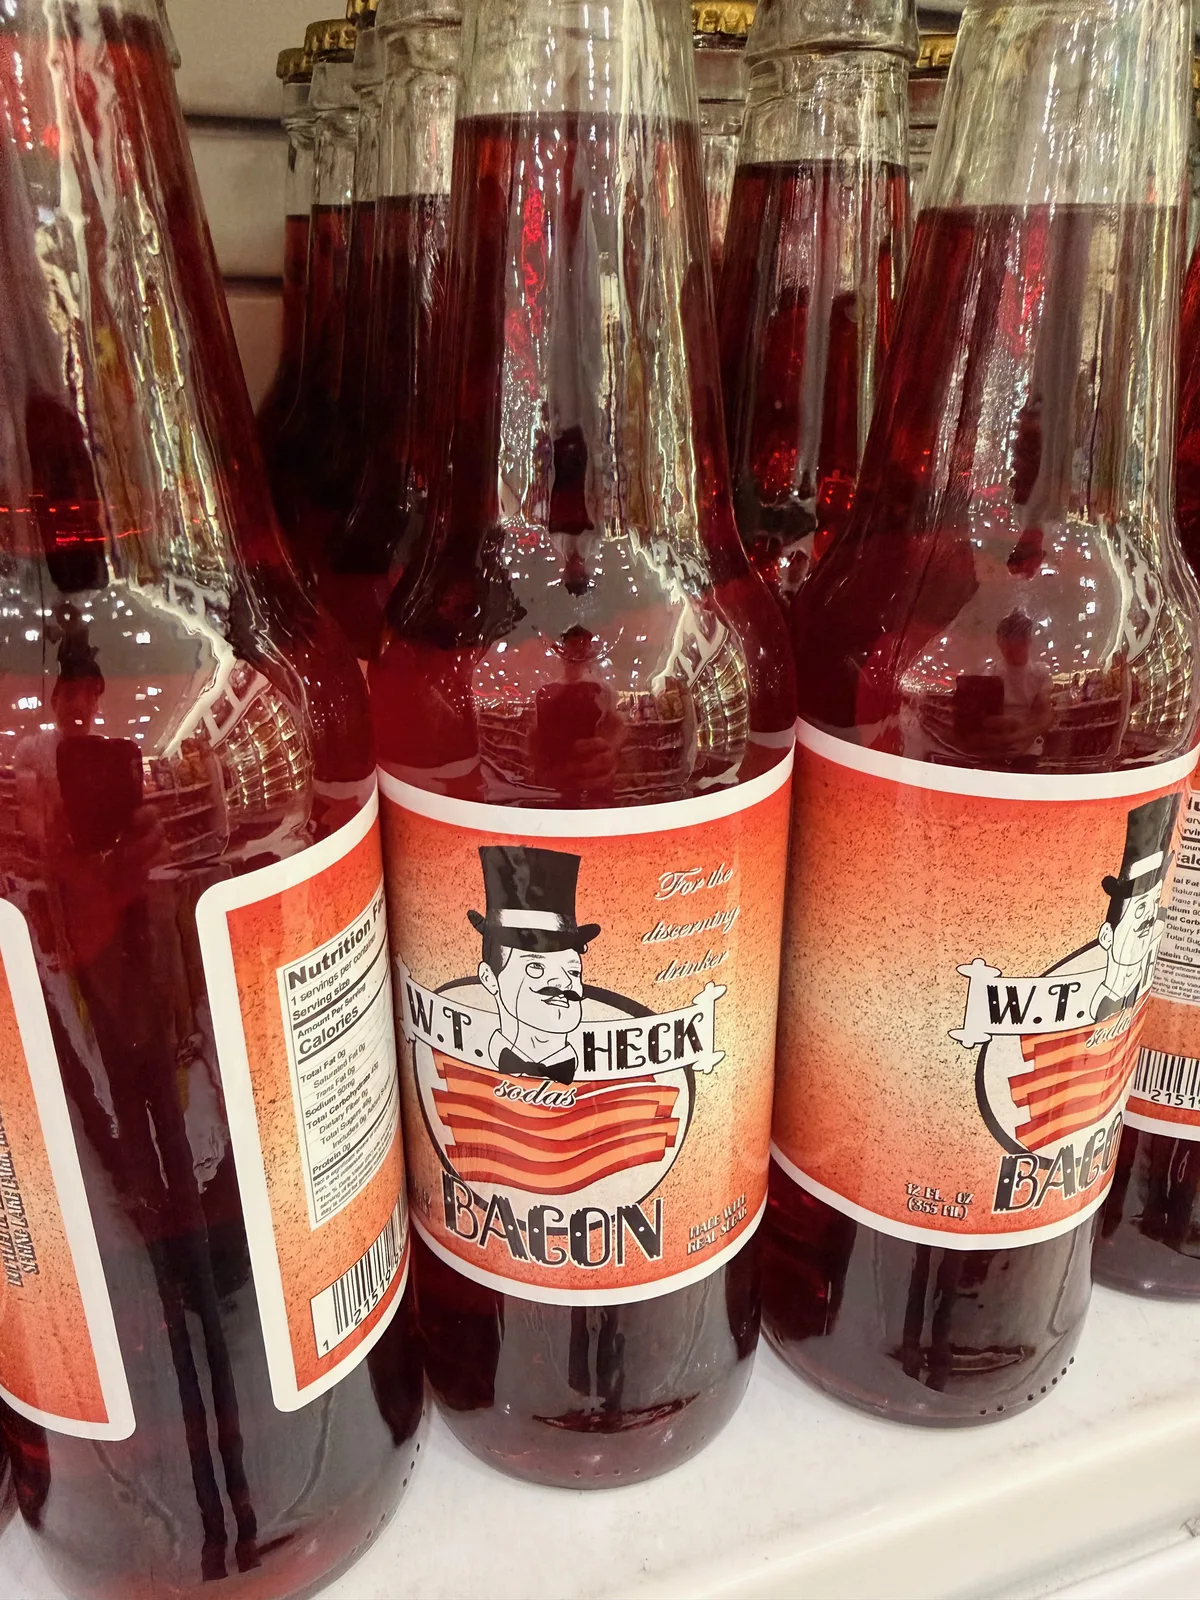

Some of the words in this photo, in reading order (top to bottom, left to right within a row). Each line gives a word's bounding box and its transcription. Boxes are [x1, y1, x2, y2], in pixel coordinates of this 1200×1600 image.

[653, 866, 705, 900] For
[706, 862, 734, 889] the
[640, 905, 740, 944] discerning
[1166, 923, 1195, 936] Dietary
[288, 919, 371, 990] Nutrition
[654, 948, 729, 983] drinker
[300, 973, 339, 1002] servings
[340, 959, 353, 977] per
[293, 993, 332, 1021] Serving
[334, 978, 351, 999] size
[986, 981, 1085, 1025] W.T.
[297, 1013, 331, 1039] Amount
[299, 1006, 360, 1055] Calories
[1085, 1009, 1134, 1049] soda
[583, 1011, 705, 1072] HECK
[300, 1066, 323, 1084] Total
[323, 1056, 336, 1070] Fat
[313, 1061, 348, 1089] Saturated
[316, 1085, 335, 1100] Trans
[335, 1073, 348, 1087] Fat
[494, 1079, 578, 1109] sodas
[1150, 1089, 1200, 1109] 2151
[305, 1095, 337, 1118] Sodium
[306, 1113, 329, 1130] Total
[329, 1073, 371, 1116] Carbohydrate
[319, 1112, 346, 1135] Dietary
[321, 1129, 341, 1145] Total
[332, 1122, 360, 1150] Includes
[312, 1150, 341, 1175] Protein
[992, 1110, 1125, 1215] BACO
[906, 1182, 921, 1196] 12
[954, 1191, 976, 1205] OZ
[906, 1196, 939, 1215] (355
[940, 1204, 970, 1220] ML)
[440, 1169, 664, 1270] BACON
[686, 1230, 718, 1256] REAL
[719, 1206, 748, 1238] SUGAR
[689, 1214, 721, 1240] MADE
[323, 1340, 329, 1351] 1
